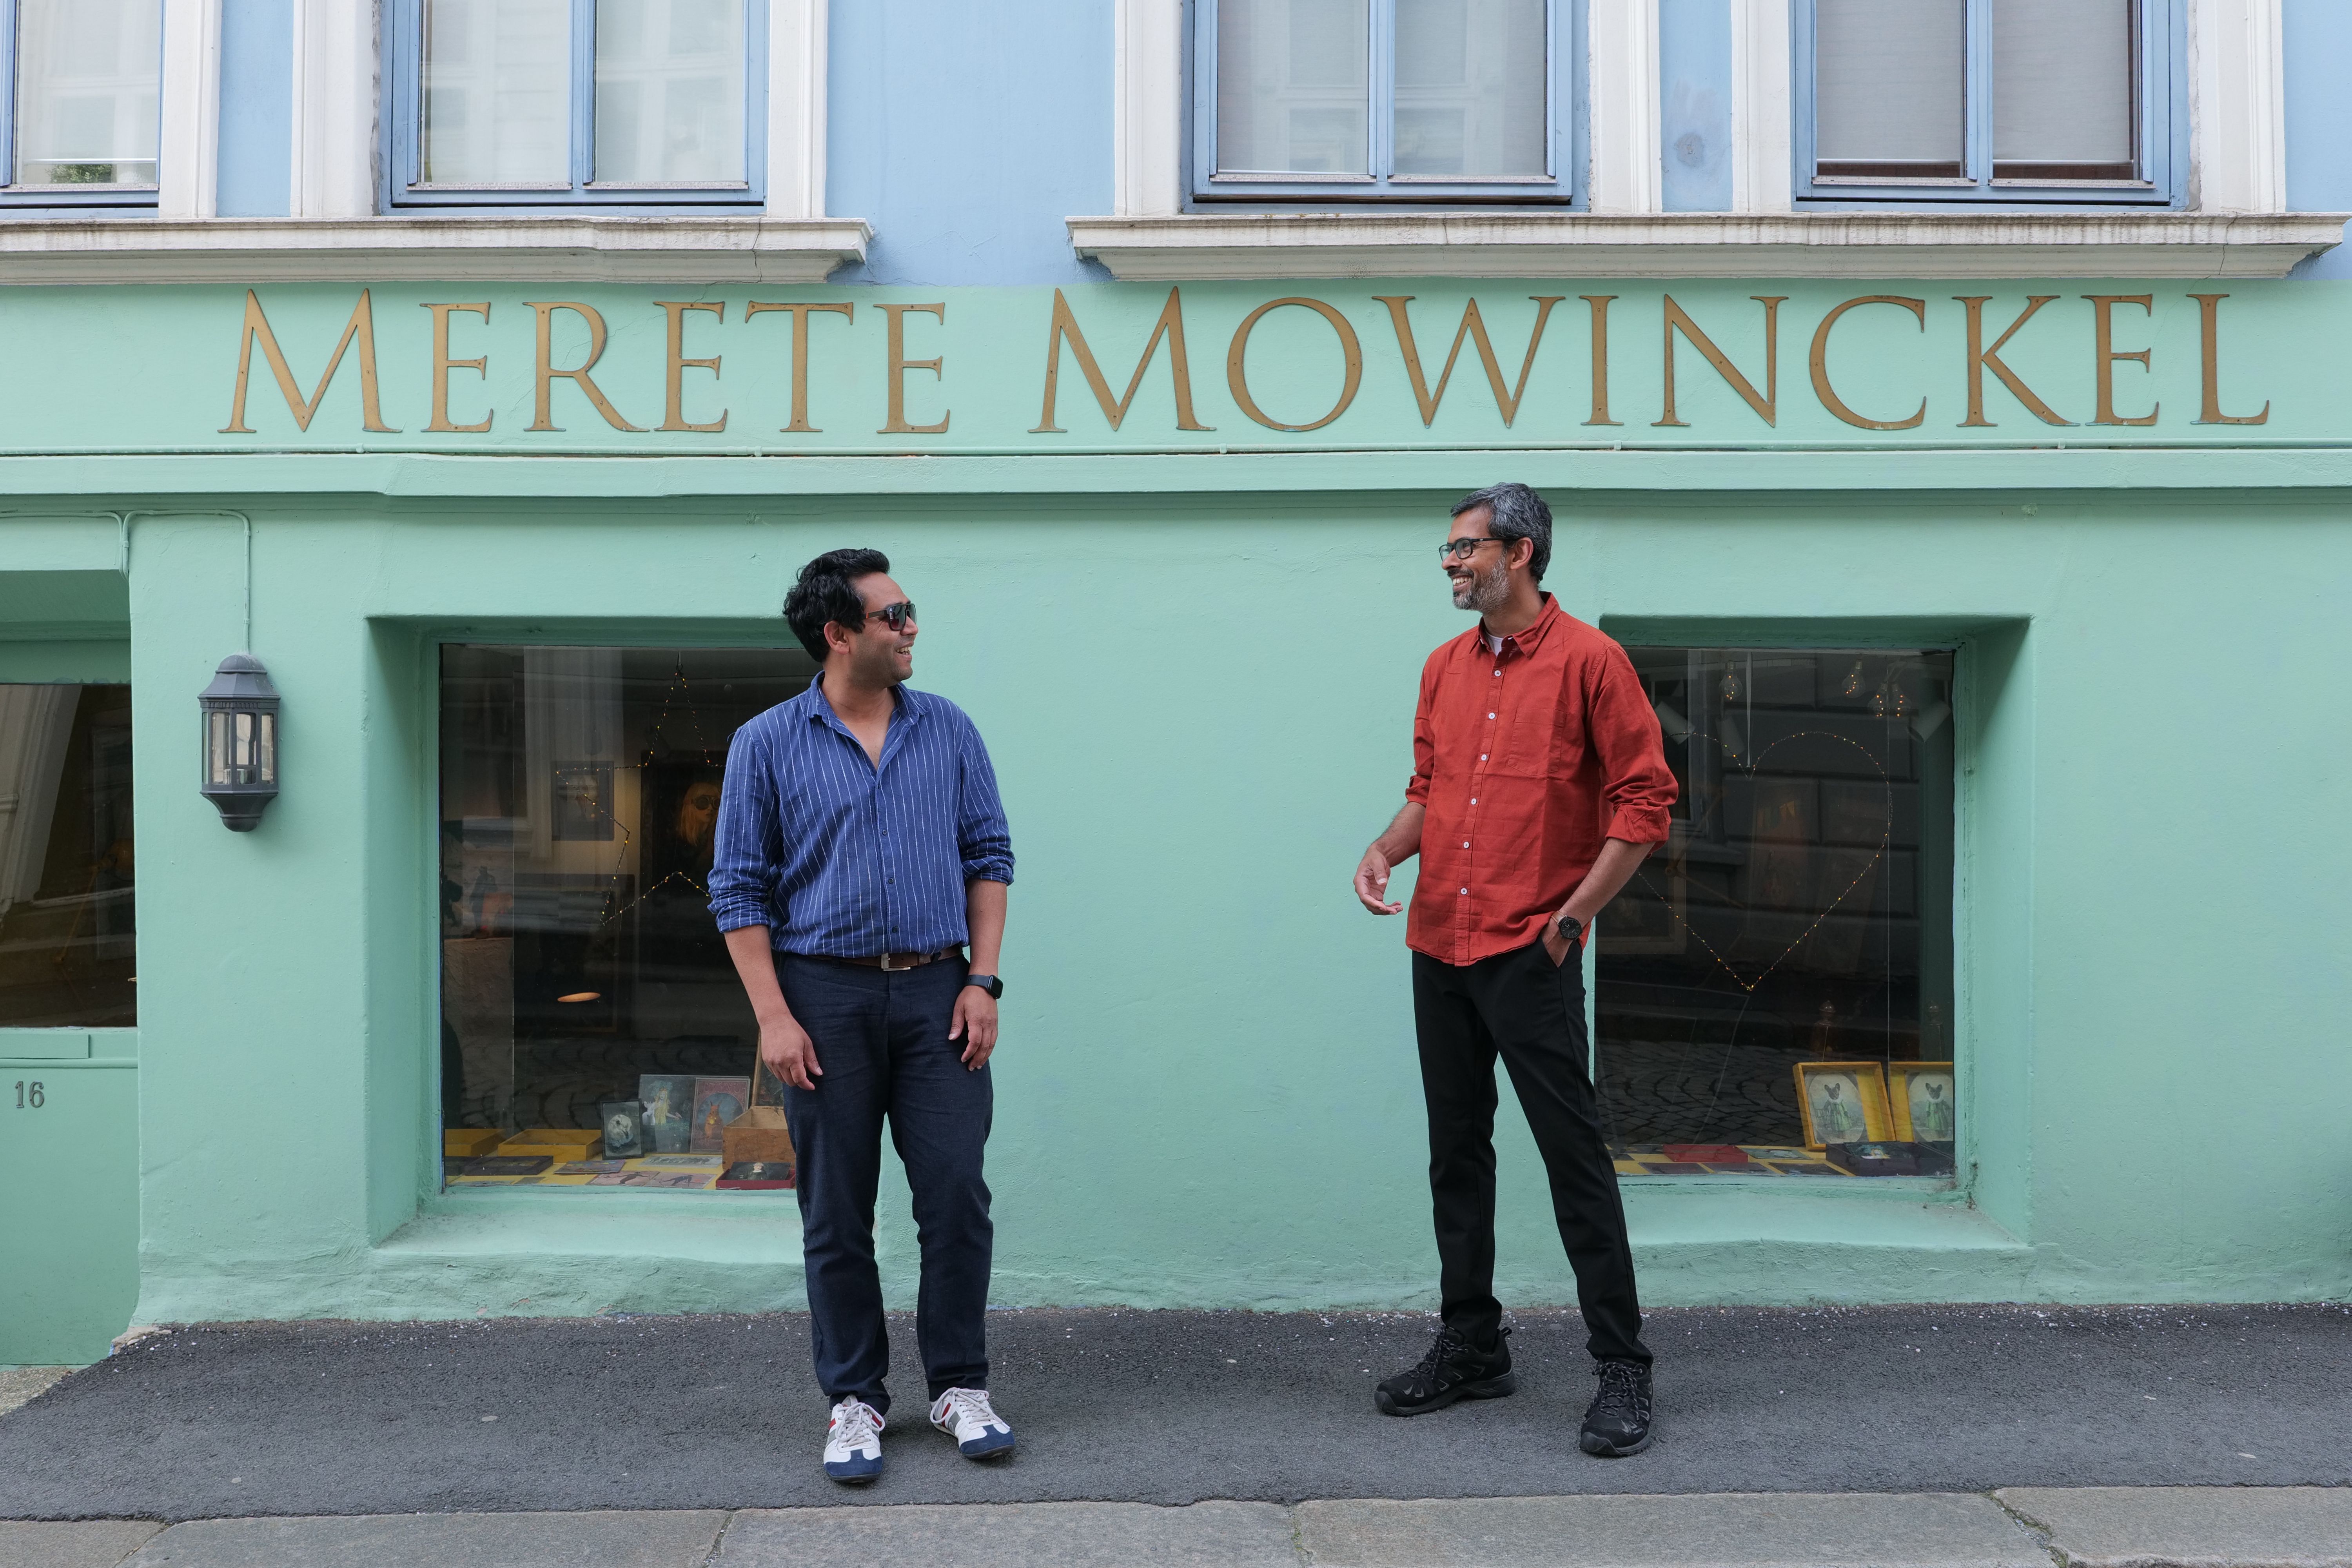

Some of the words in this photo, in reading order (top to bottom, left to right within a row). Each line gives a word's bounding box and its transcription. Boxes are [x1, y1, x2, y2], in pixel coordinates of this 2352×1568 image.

[217, 288, 949, 433] MERETE
[1027, 286, 2269, 433] MOWINCKEL
[15, 1081, 44, 1108] 16
